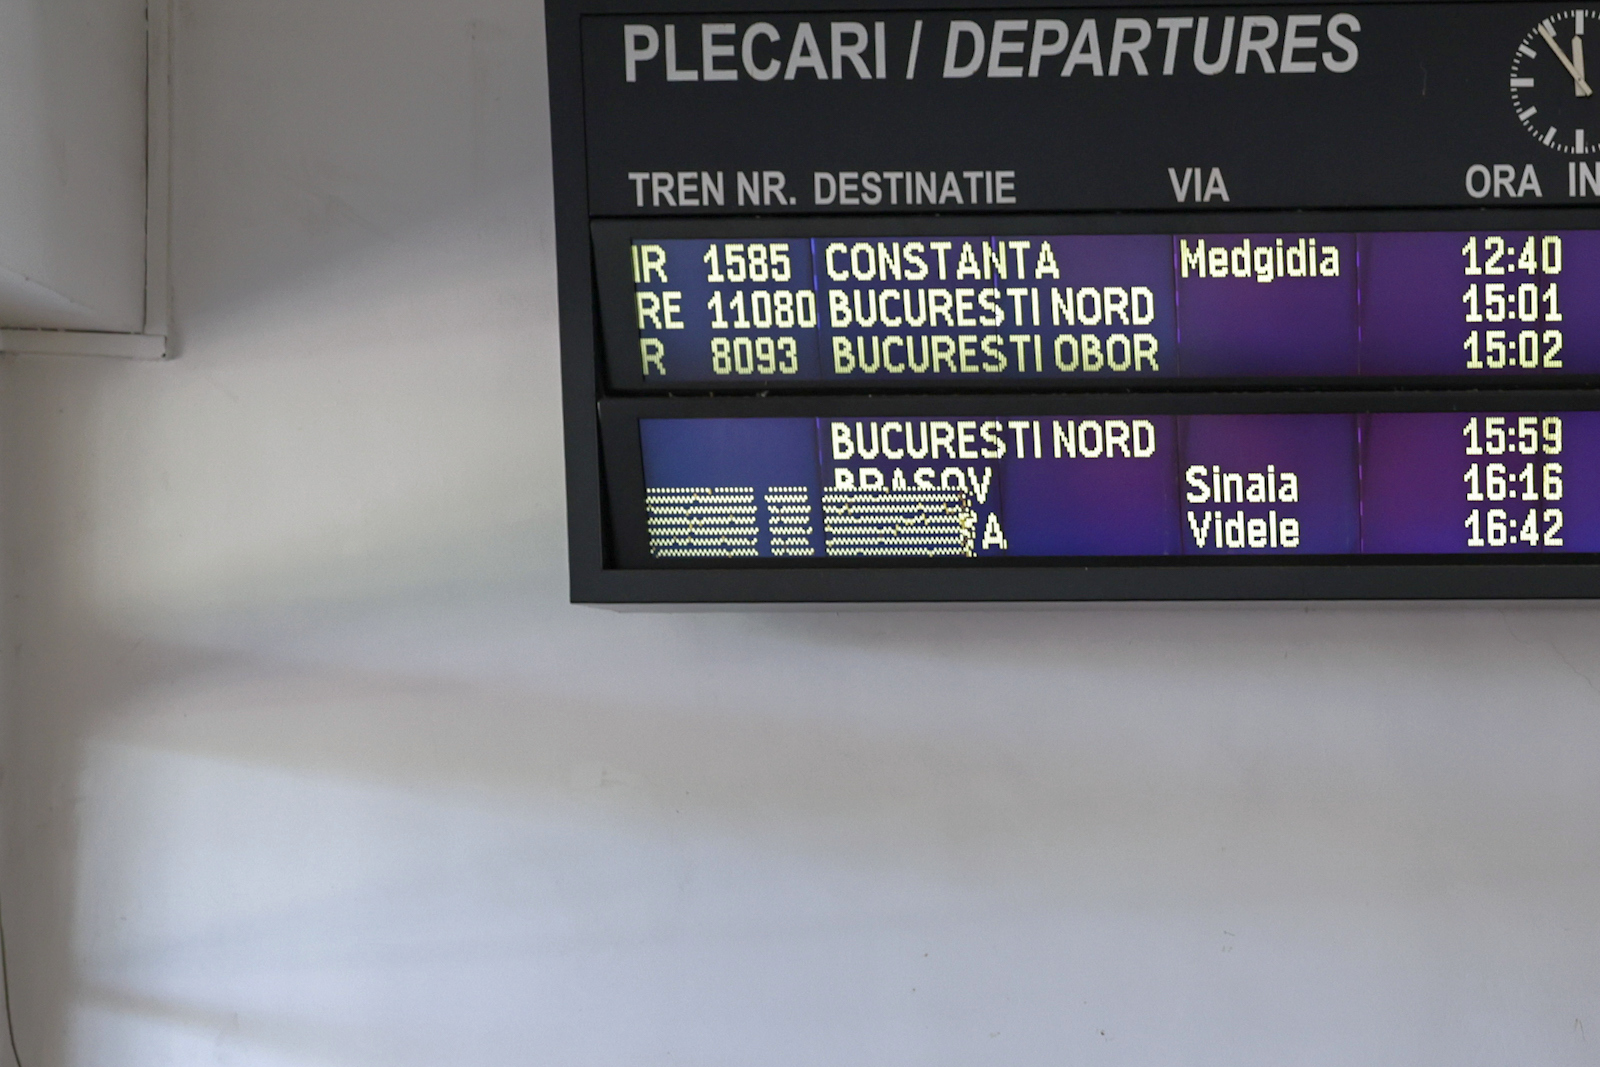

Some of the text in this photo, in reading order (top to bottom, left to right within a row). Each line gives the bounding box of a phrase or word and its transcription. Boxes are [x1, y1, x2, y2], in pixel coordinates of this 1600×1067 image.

[625, 14, 1360, 81] PLECARI / DEPARTURES
[629, 172, 724, 206] TREN
[737, 171, 796, 205] NR.
[815, 171, 1016, 204] DESTINATIE
[1168, 168, 1229, 202] VIA
[1466, 164, 1542, 198] ORA
[633, 245, 667, 282] IR
[704, 244, 790, 282] 1585
[826, 241, 1059, 281] CONSTANTA
[1181, 238, 1339, 282] Medgidia
[1462, 236, 1561, 275] 12:40
[637, 291, 684, 329] RE
[708, 290, 816, 328] 11080
[829, 288, 1039, 327] BUCURESTI
[1052, 287, 1154, 325] NORD
[1463, 283, 1562, 322] 15:01
[641, 338, 665, 374] R
[711, 337, 797, 374] 8093
[833, 335, 1041, 373] BUCURESTI
[1055, 334, 1158, 371] OBOR
[1464, 330, 1562, 368] 15:02
[832, 421, 1041, 459] BUCURESTI
[1053, 420, 1155, 458] NORD
[1464, 417, 1562, 455] 15:59
[1186, 465, 1297, 503] Sinaia
[1464, 463, 1562, 500] 16:16
[1188, 511, 1299, 548] Videle
[1465, 509, 1563, 546] 16:42
